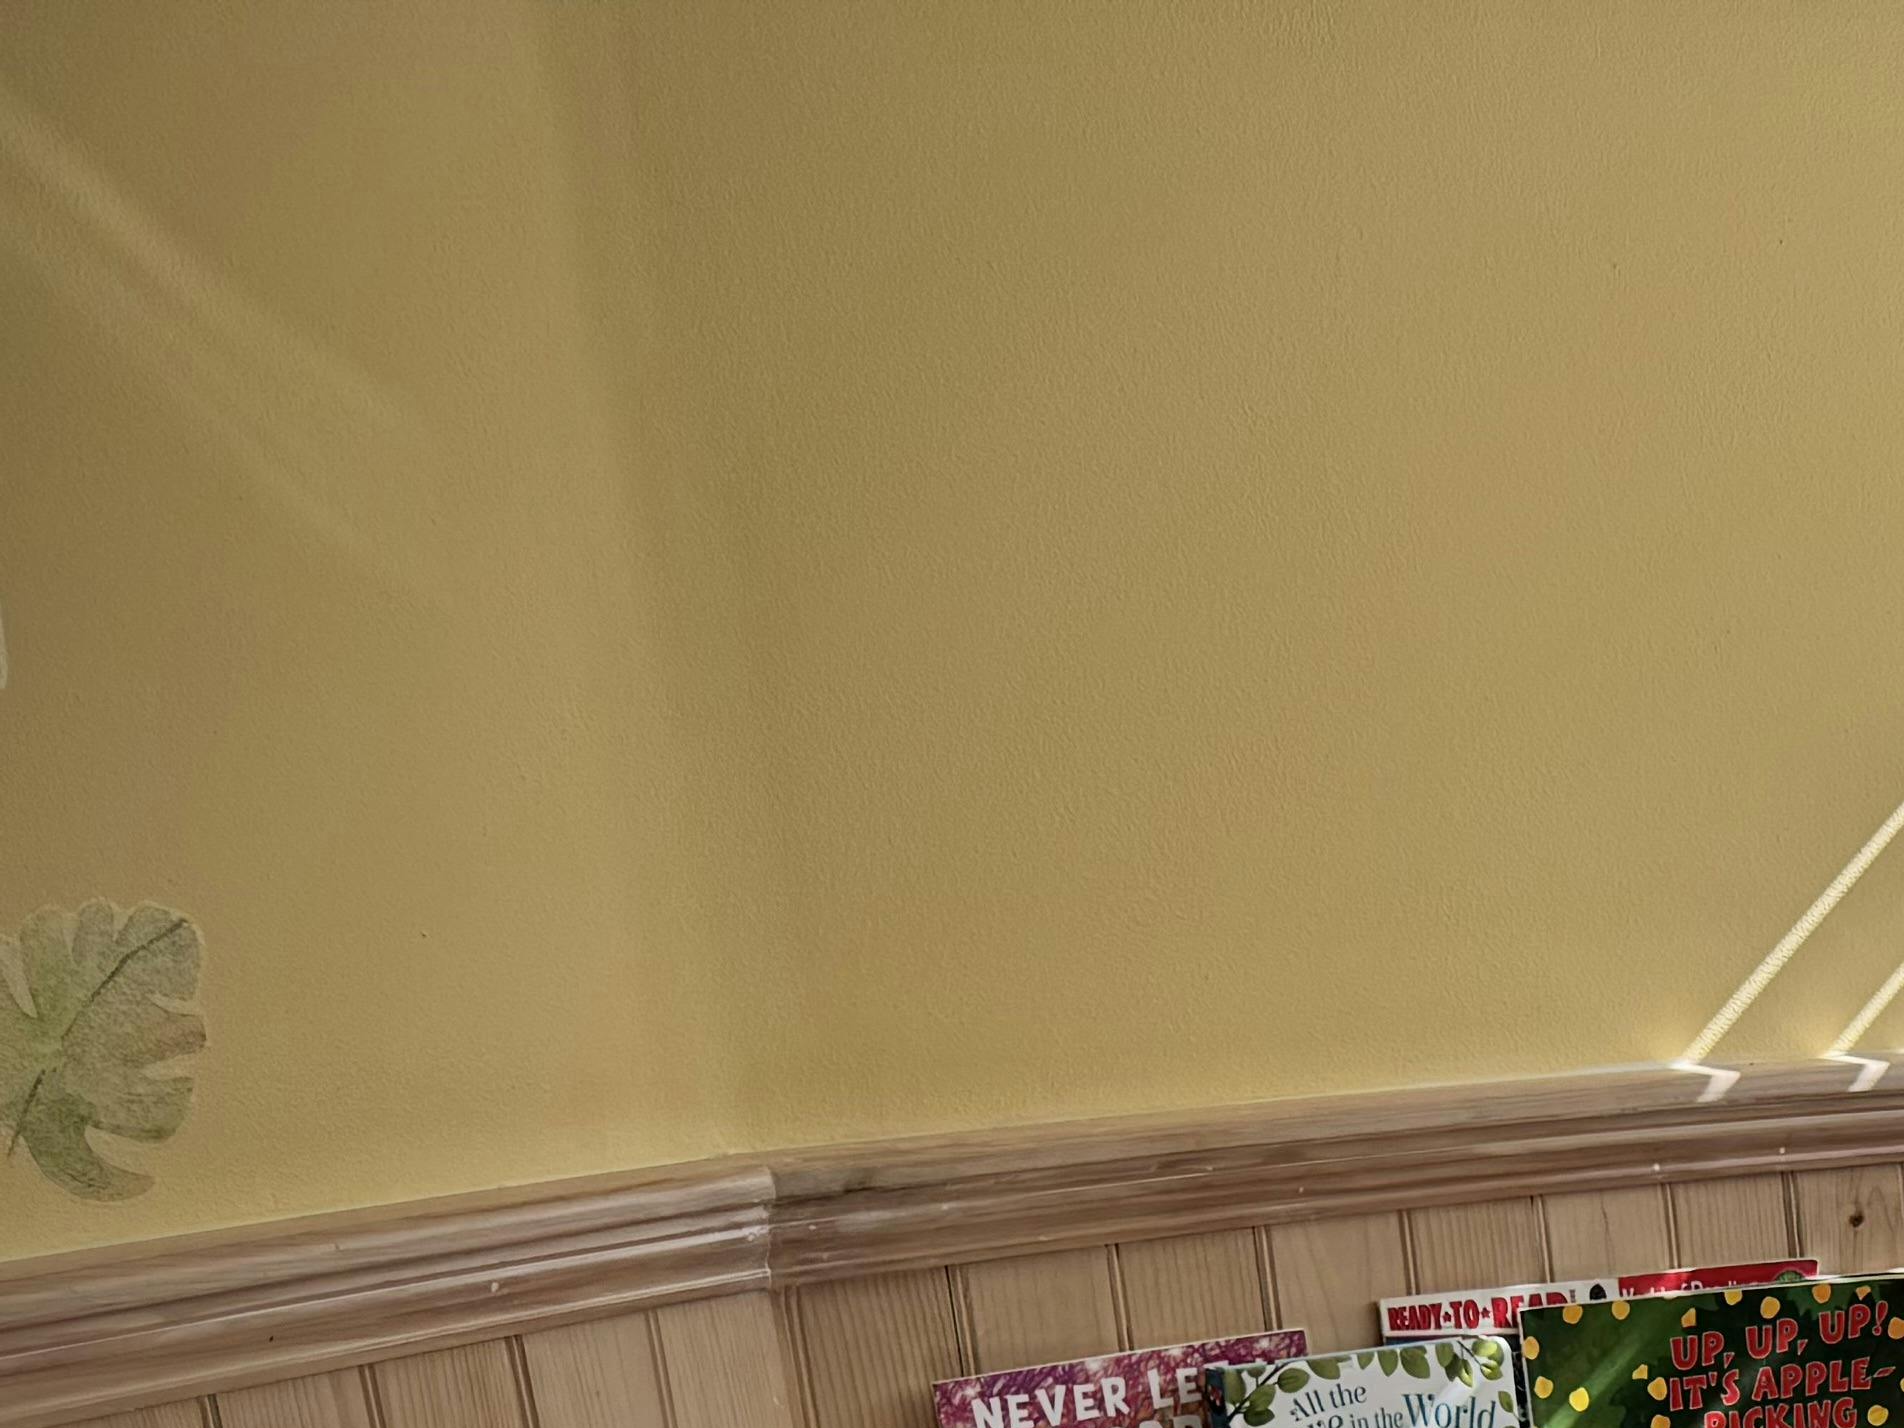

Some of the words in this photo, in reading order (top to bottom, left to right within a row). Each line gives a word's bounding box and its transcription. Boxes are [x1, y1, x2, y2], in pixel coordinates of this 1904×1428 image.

[1670, 1331, 1735, 1370] UP,
[1745, 1318, 1808, 1360] UP,
[1818, 1300, 1889, 1344] UP!
[1290, 1390, 1326, 1421] All
[1329, 1383, 1368, 1409] the
[1669, 1368, 1741, 1412] IT'S
[1751, 1356, 1896, 1401] APPLE-
